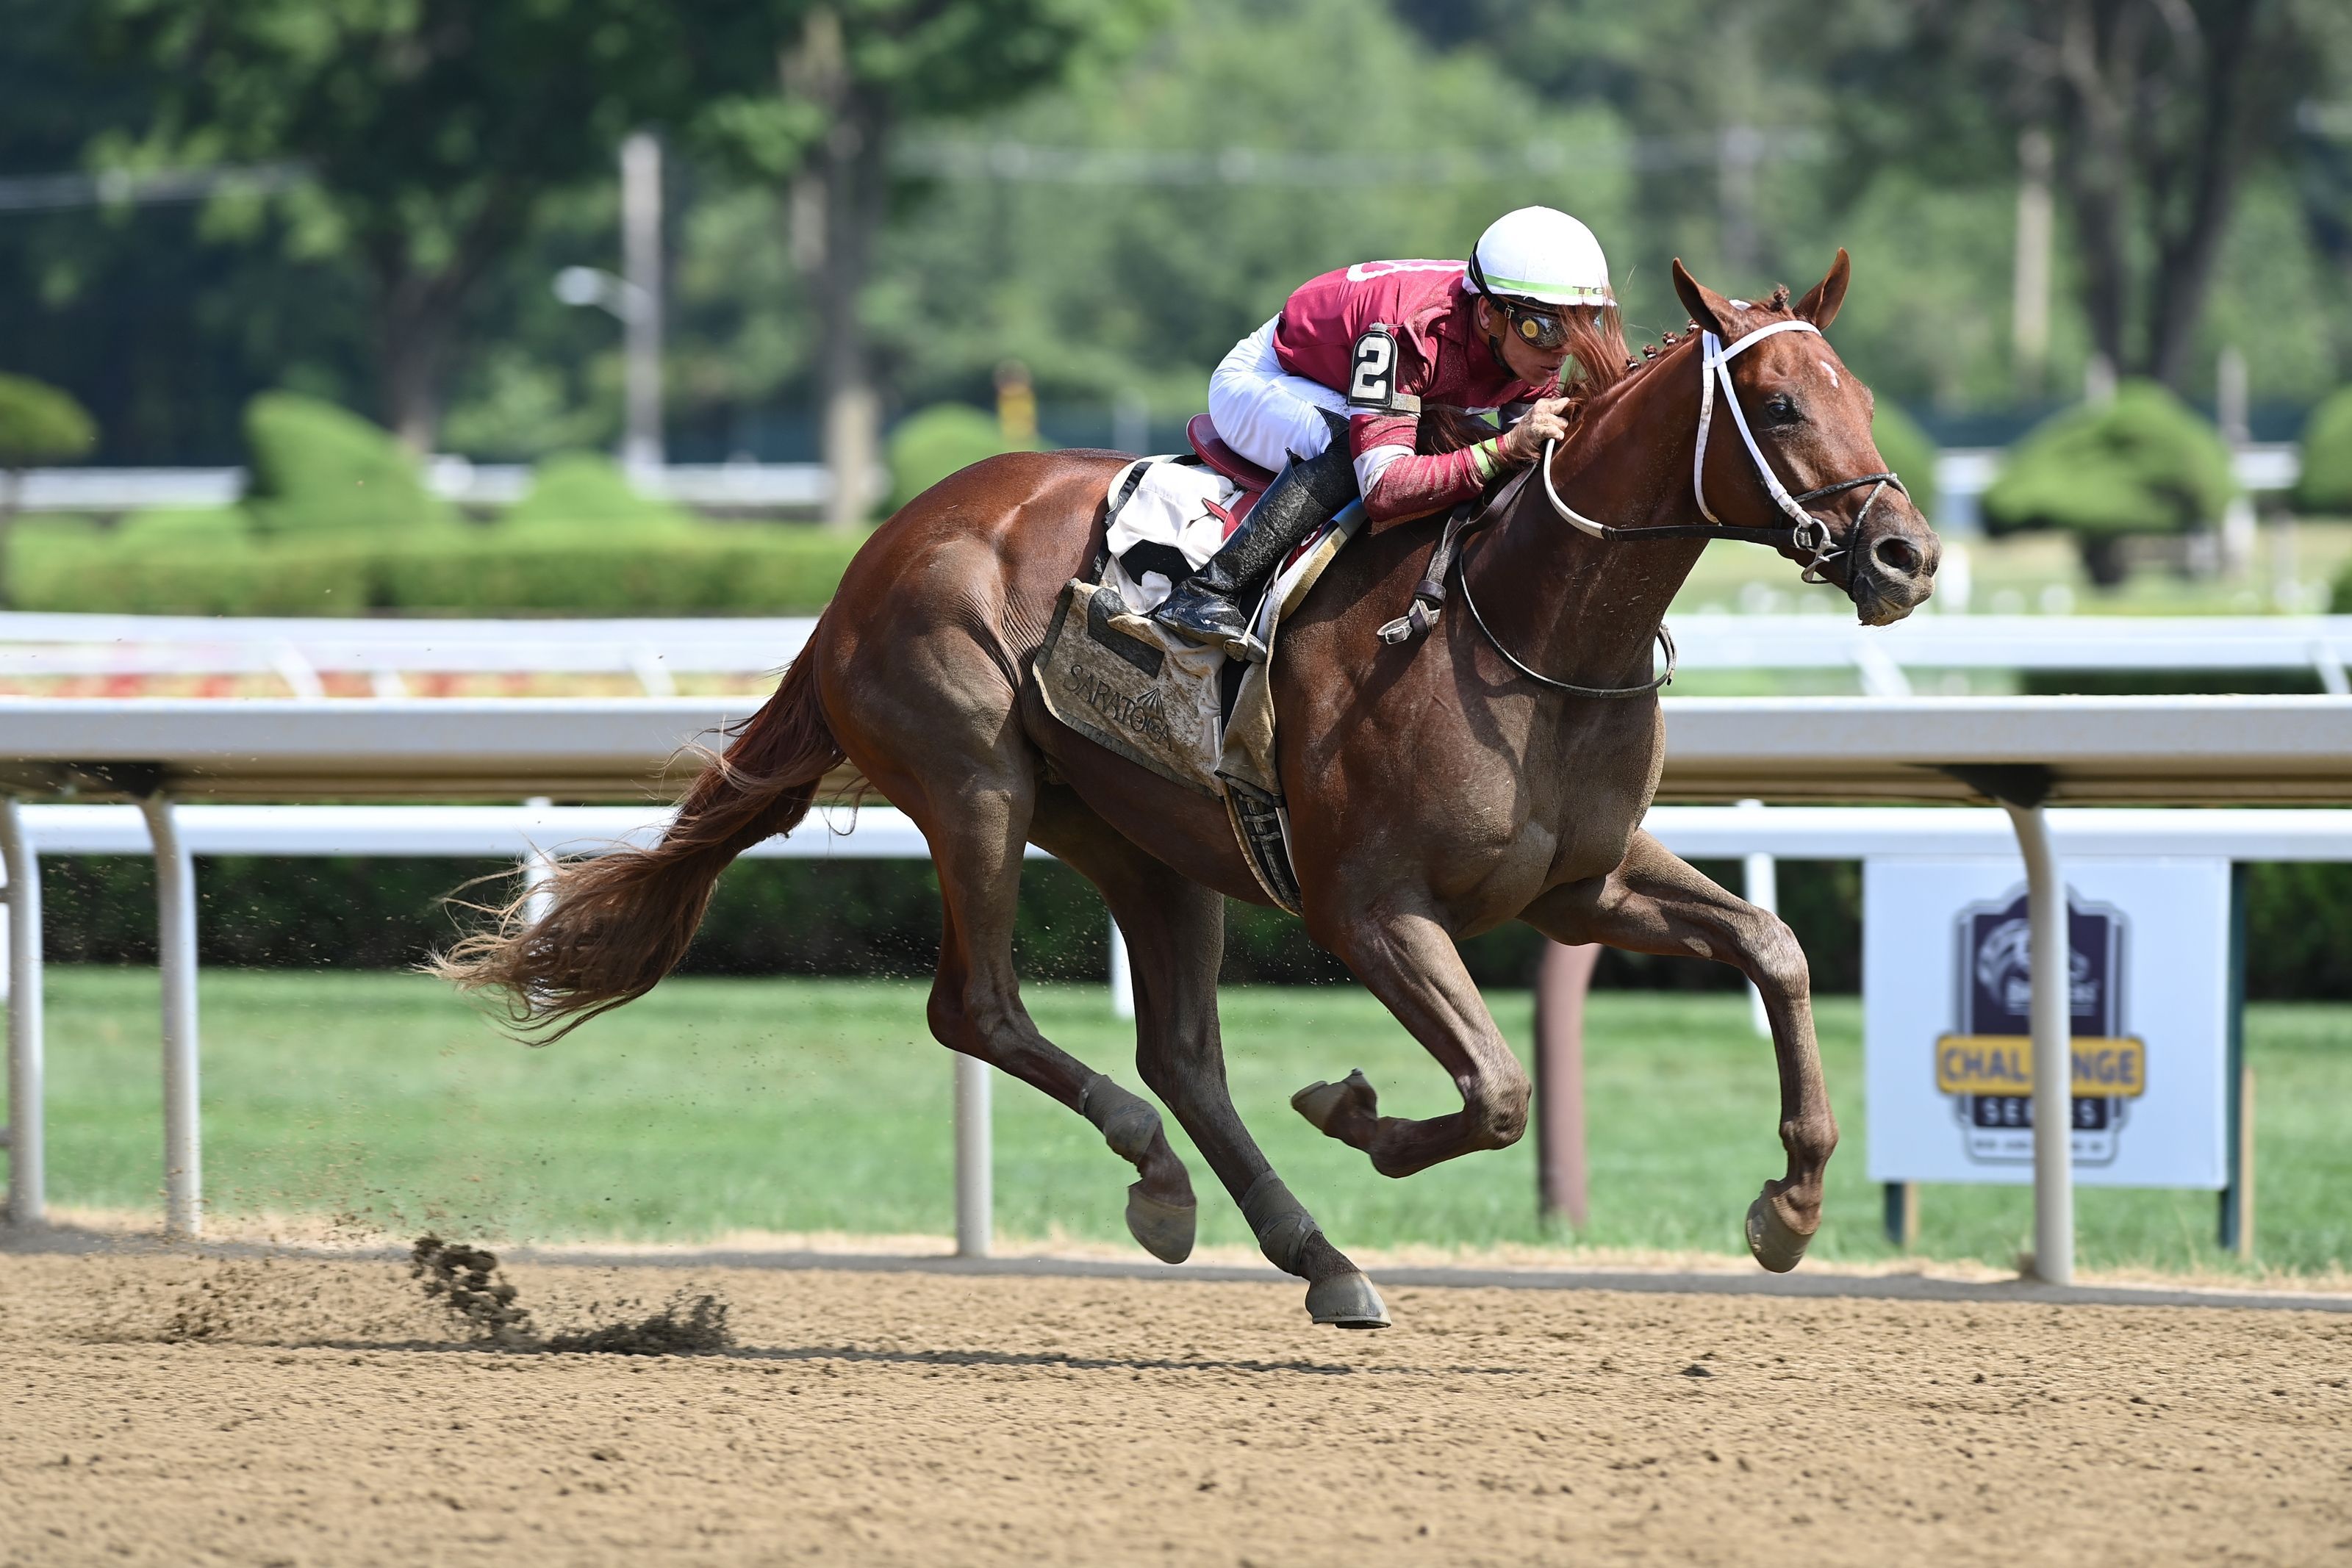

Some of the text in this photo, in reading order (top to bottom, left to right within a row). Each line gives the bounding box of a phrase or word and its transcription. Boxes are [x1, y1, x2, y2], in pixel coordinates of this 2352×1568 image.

[1352, 337, 1391, 399] 2
[1063, 663, 1173, 752] SARATOGA
[1944, 1047, 2136, 1085] CHALNGE
